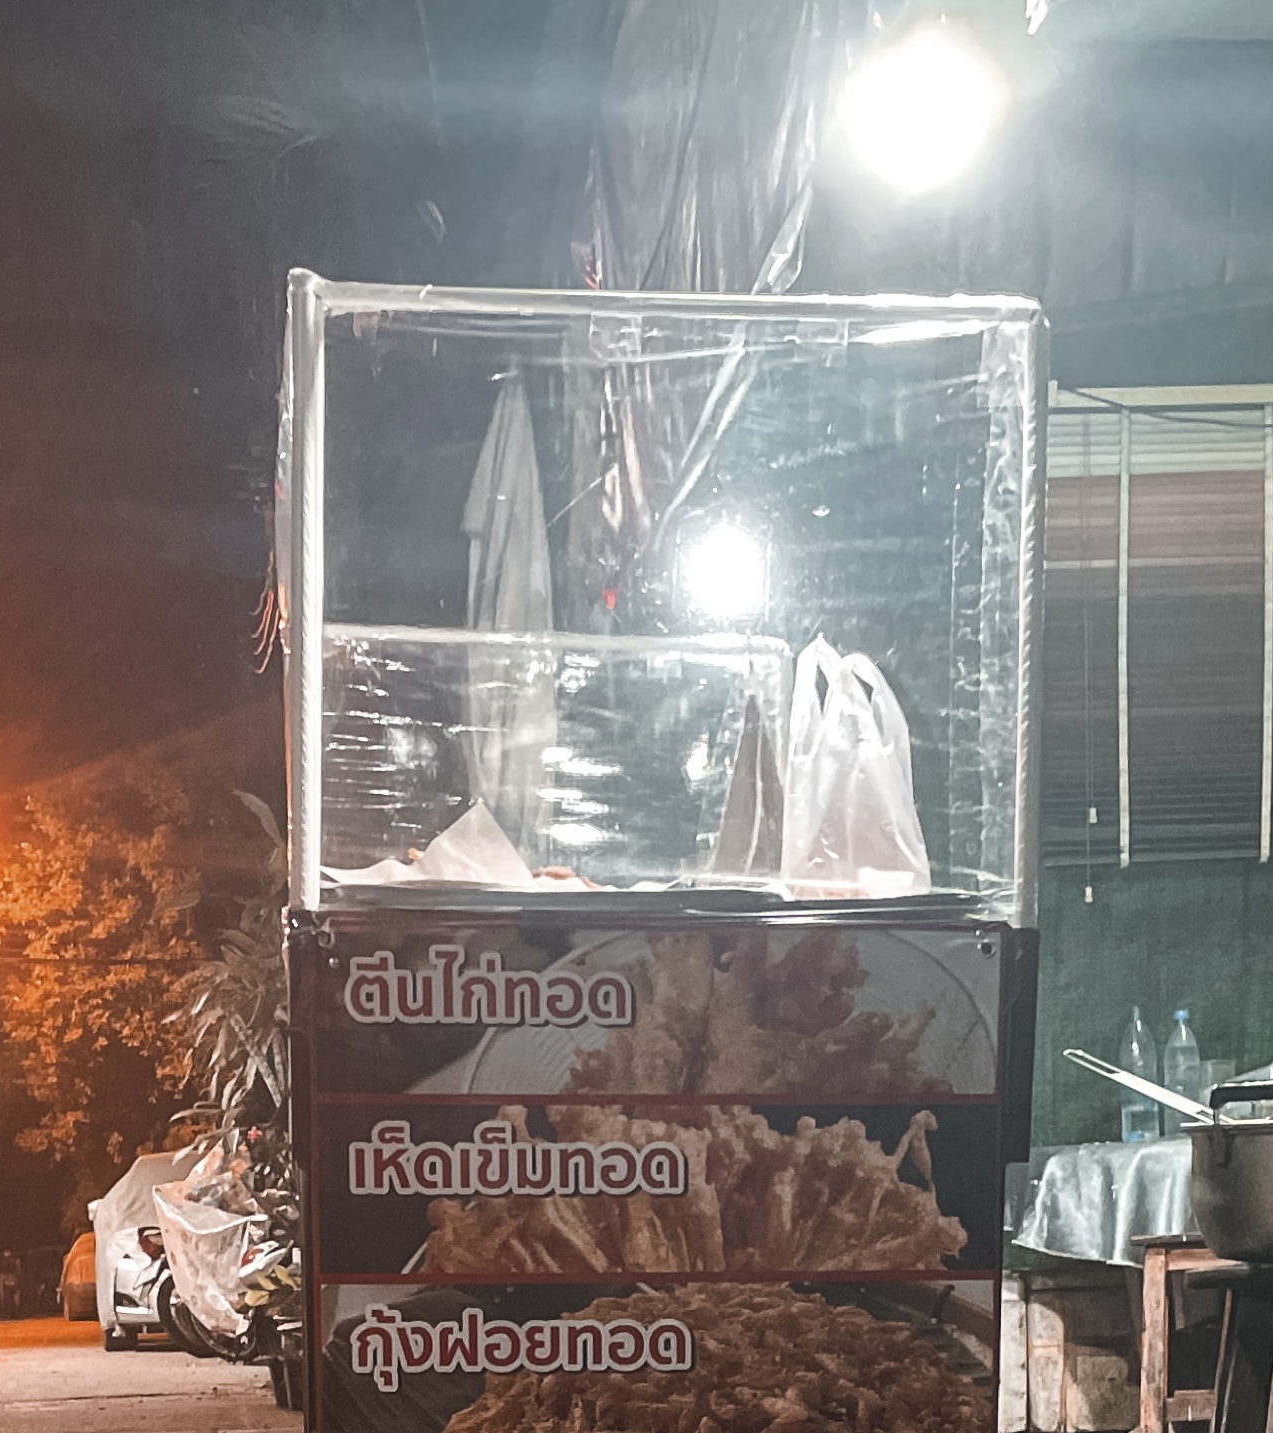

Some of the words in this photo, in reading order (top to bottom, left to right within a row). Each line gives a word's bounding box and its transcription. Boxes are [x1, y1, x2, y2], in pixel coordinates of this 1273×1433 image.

[347, 947, 631, 1024] ตีนไก่ทอด
[351, 1123, 683, 1193] เห็ดเข็มทอด
[353, 1306, 689, 1390] กุ้งฝอยทอด
